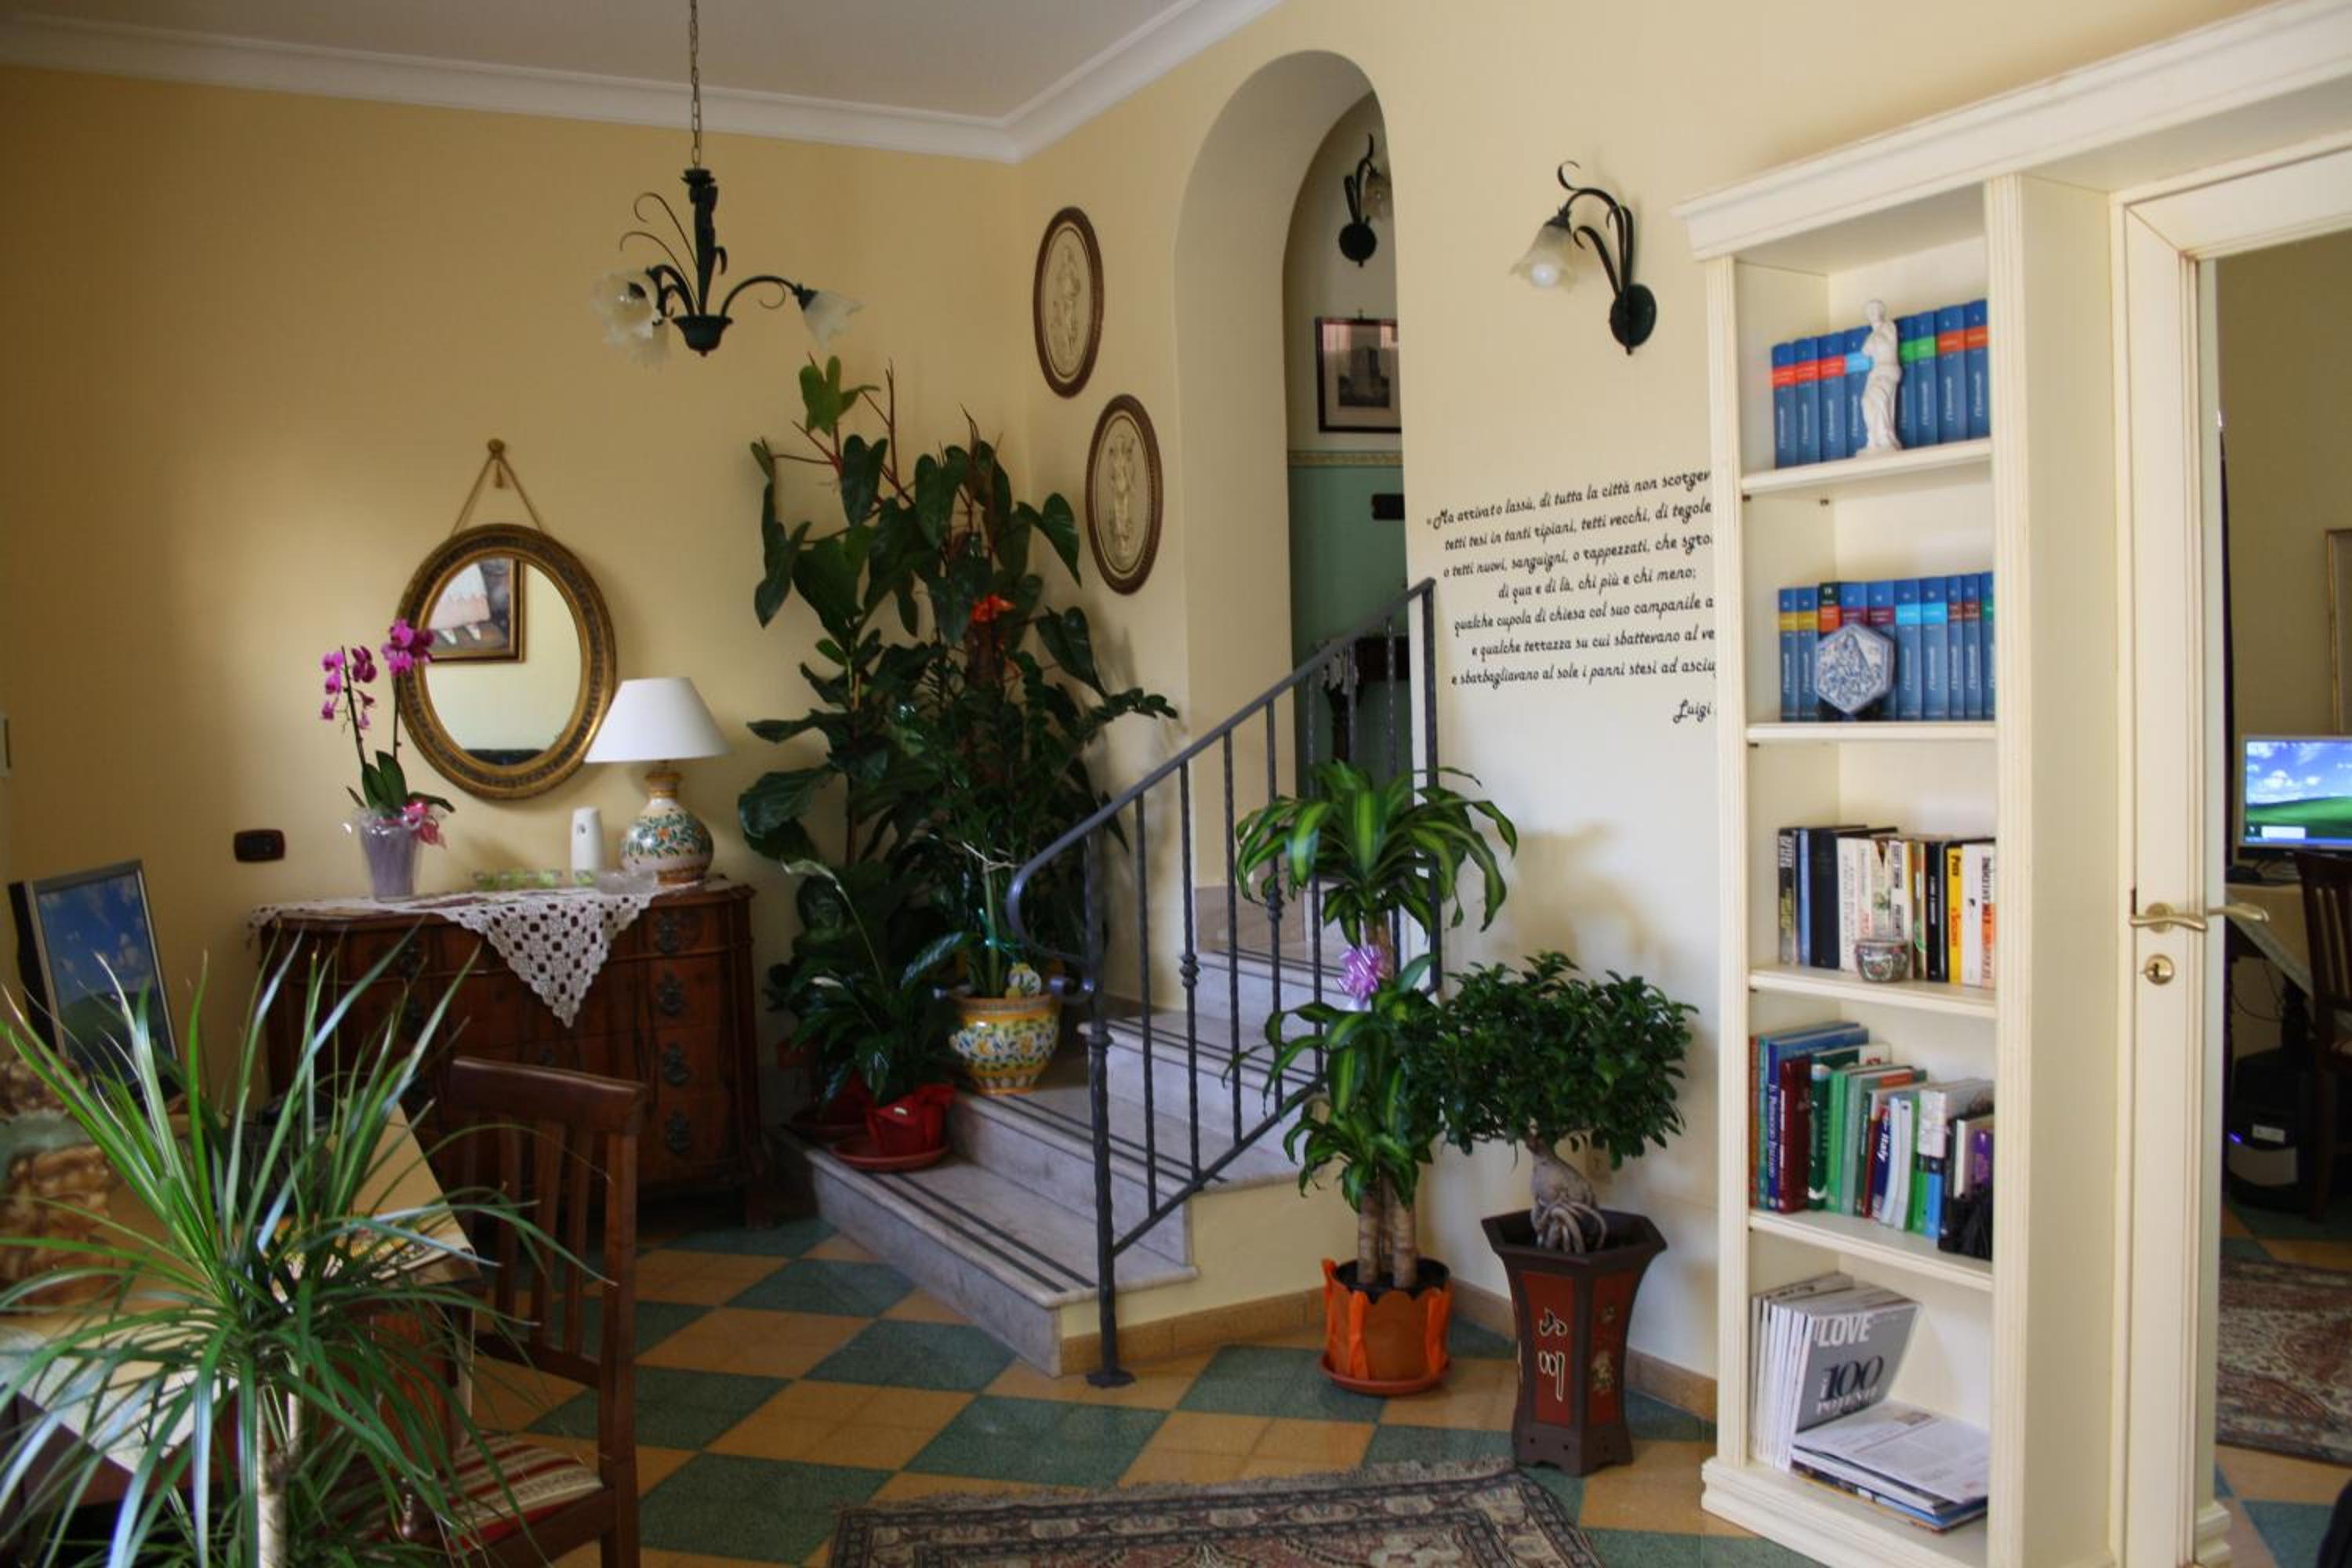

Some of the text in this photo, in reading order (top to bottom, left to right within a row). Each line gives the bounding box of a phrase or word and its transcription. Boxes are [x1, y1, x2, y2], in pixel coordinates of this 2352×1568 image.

[1457, 504, 1503, 522] arrivato
[1540, 491, 1552, 508] di
[1555, 489, 1583, 506] tutta
[1586, 483, 1598, 501] la
[1602, 481, 1630, 499] città
[1634, 479, 1657, 493] non
[1445, 535, 1467, 551] tetti
[1469, 533, 1488, 548] tesi
[1490, 531, 1501, 545] in
[1504, 526, 1531, 543] tanti
[1581, 514, 1606, 532] tetti
[1655, 502, 1668, 521] di
[1672, 495, 1712, 524] tegole
[1443, 568, 1450, 578] o
[1452, 562, 1474, 577] tetti
[1573, 551, 1580, 562] o
[1655, 532, 1678, 550] che
[1498, 583, 1509, 599] di
[1512, 586, 1533, 605] qua
[1535, 585, 1542, 595] e
[1544, 576, 1556, 593] di
[1578, 572, 1597, 590] chi
[1599, 572, 1620, 595] più
[1623, 575, 1630, 586] e
[1634, 566, 1653, 584] chi
[1454, 612, 1494, 638] qualche
[1496, 608, 1533, 633] cupola
[1534, 607, 1548, 623] di
[1549, 605, 1585, 622] chiesa
[1589, 601, 1607, 619] col
[1610, 604, 1630, 617] suo
[1634, 592, 1701, 621] campanile
[1472, 647, 1479, 657] e
[1479, 637, 1522, 663] qualche
[1524, 638, 1573, 654] terrazza
[1576, 637, 1589, 650] su
[1592, 634, 1610, 648] cui
[1613, 629, 1682, 647] sbattevano
[1684, 623, 1700, 641] al
[1451, 675, 1457, 686] e
[1460, 667, 1540, 691] sbarbagliavano
[1542, 662, 1555, 681] al
[1557, 661, 1579, 679] sole
[1582, 664, 1588, 679] i
[1588, 662, 1626, 686] panni
[1628, 659, 1657, 676] stesi
[1661, 655, 1679, 674] ad
[1672, 698, 1712, 724] Luigi
[1821, 1356, 1885, 1403] 100
